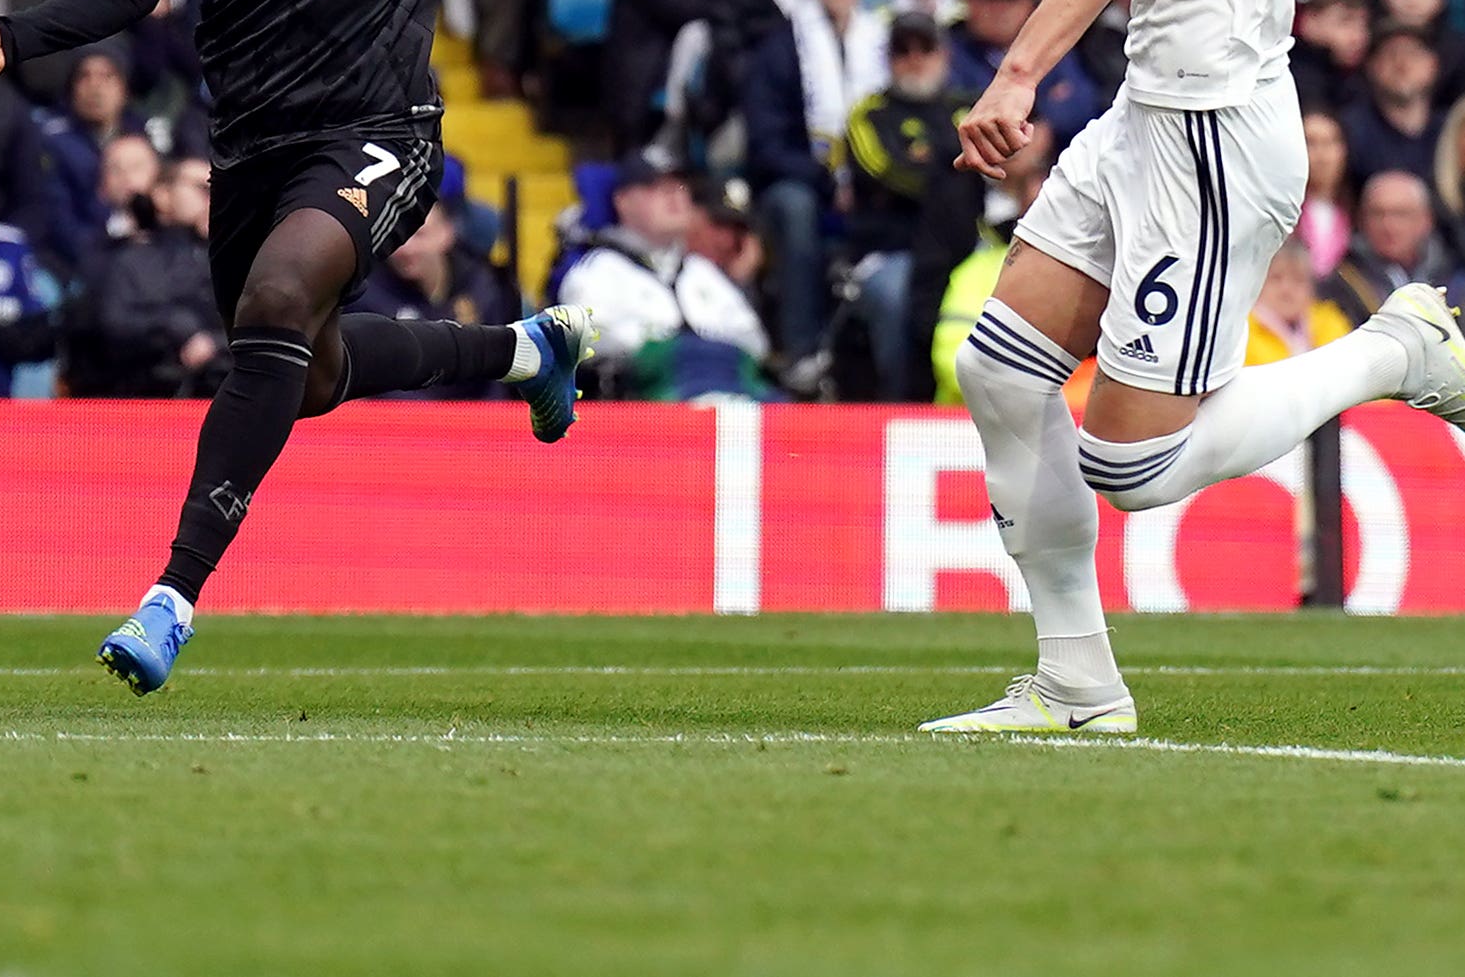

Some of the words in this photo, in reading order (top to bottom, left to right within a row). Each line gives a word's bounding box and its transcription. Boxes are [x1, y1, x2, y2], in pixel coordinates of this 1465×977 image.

[354, 142, 401, 186] 7
[1134, 255, 1179, 326] 6
[1119, 346, 1159, 364] adidas
